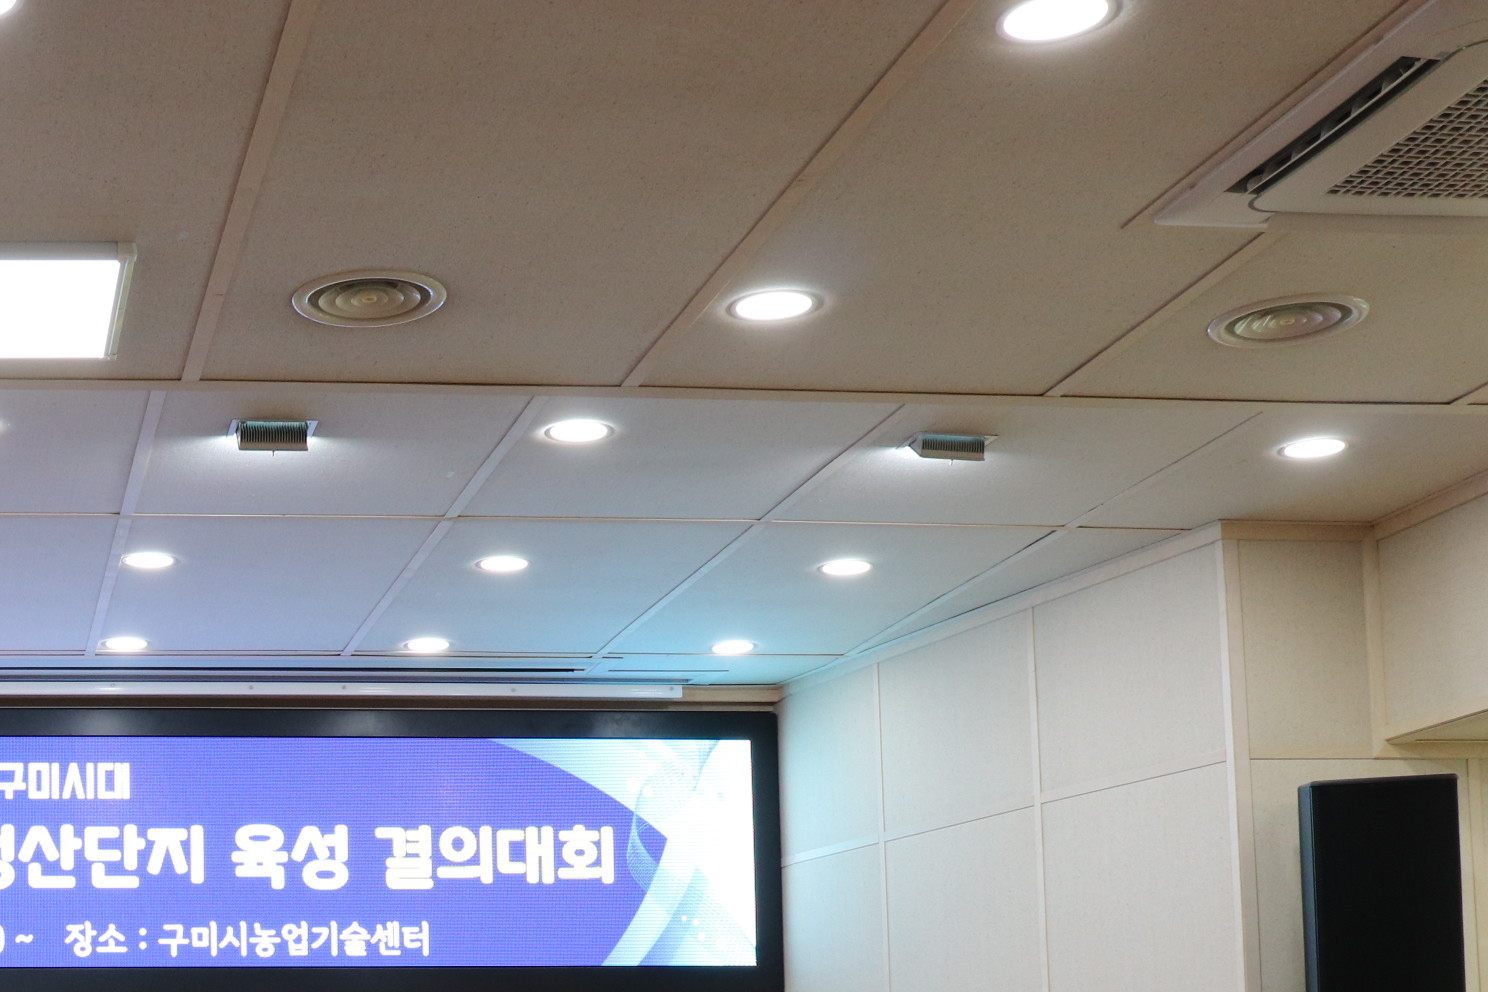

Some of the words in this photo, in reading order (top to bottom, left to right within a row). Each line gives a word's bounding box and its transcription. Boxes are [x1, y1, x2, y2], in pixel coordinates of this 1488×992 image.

[231, 824, 349, 891] 육성
[375, 824, 616, 891] 결의대회
[64, 922, 128, 957] 장소
[157, 922, 431, 957] 구미시농업기술센터
